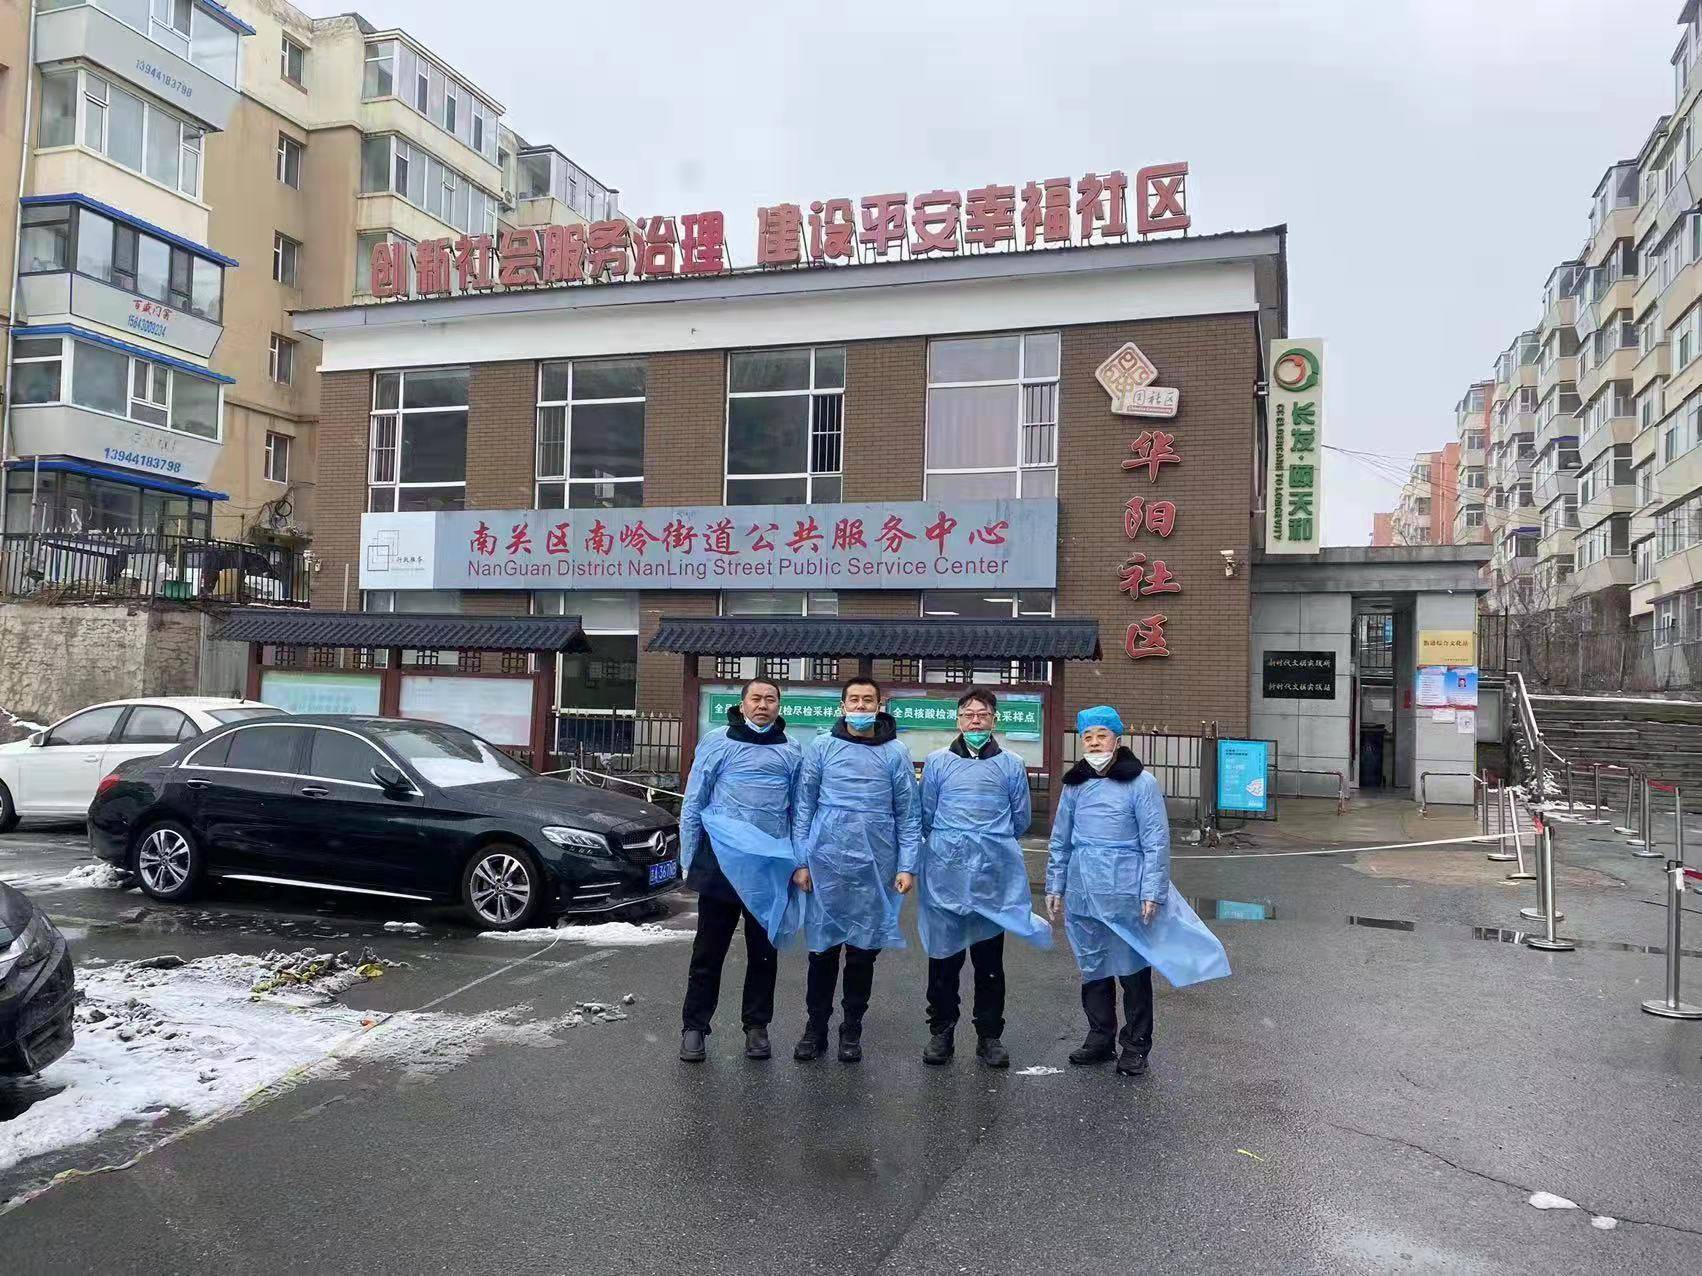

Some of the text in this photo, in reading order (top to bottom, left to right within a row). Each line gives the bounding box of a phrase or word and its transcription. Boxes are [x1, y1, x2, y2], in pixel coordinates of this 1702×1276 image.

[136, 59, 193, 97] 13944183798
[370, 161, 1191, 299] 创新社会服务治理 建设平安幸福社区
[104, 447, 182, 473] 13944183798
[1274, 472, 1284, 486] TO
[469, 510, 1010, 557] 南关区南岭街道公共服务中心
[1117, 430, 1182, 660] 华阳社区
[468, 556, 1009, 580] NanGuan District NanLing Street Public Service Center
